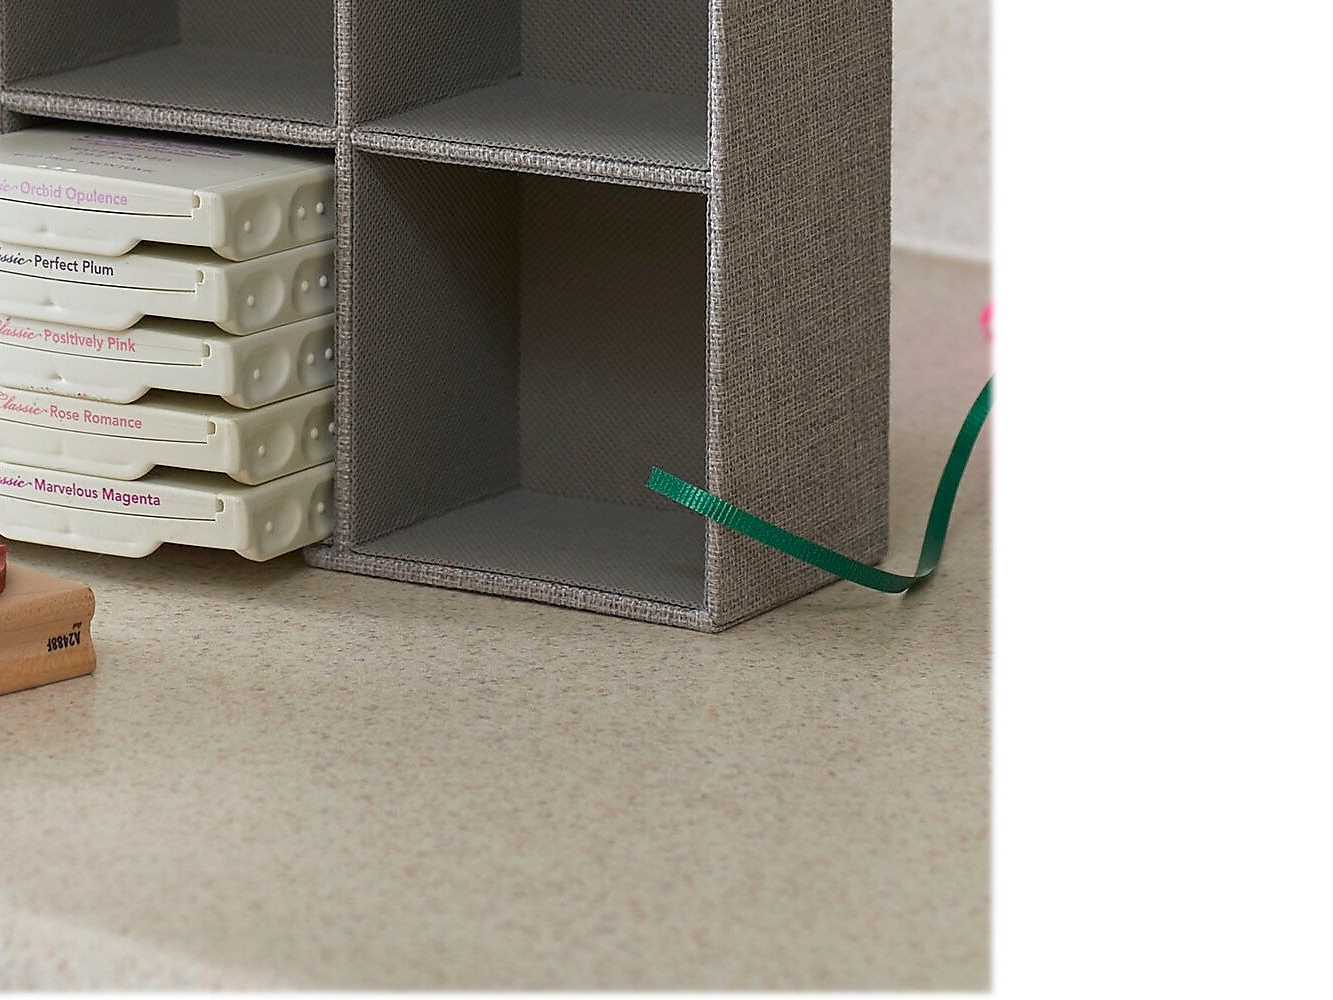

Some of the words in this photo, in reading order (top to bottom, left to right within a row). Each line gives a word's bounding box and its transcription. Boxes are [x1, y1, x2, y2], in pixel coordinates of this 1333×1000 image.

[66, 186, 128, 206] Opulence
[34, 255, 78, 272] Perfect
[82, 259, 114, 276] Plum
[43, 328, 104, 351] Positively
[107, 336, 136, 352] Pink
[49, 404, 79, 421] Rose
[83, 409, 142, 429] Romance
[34, 477, 98, 499] Marvelous
[101, 488, 161, 507] Magenta
